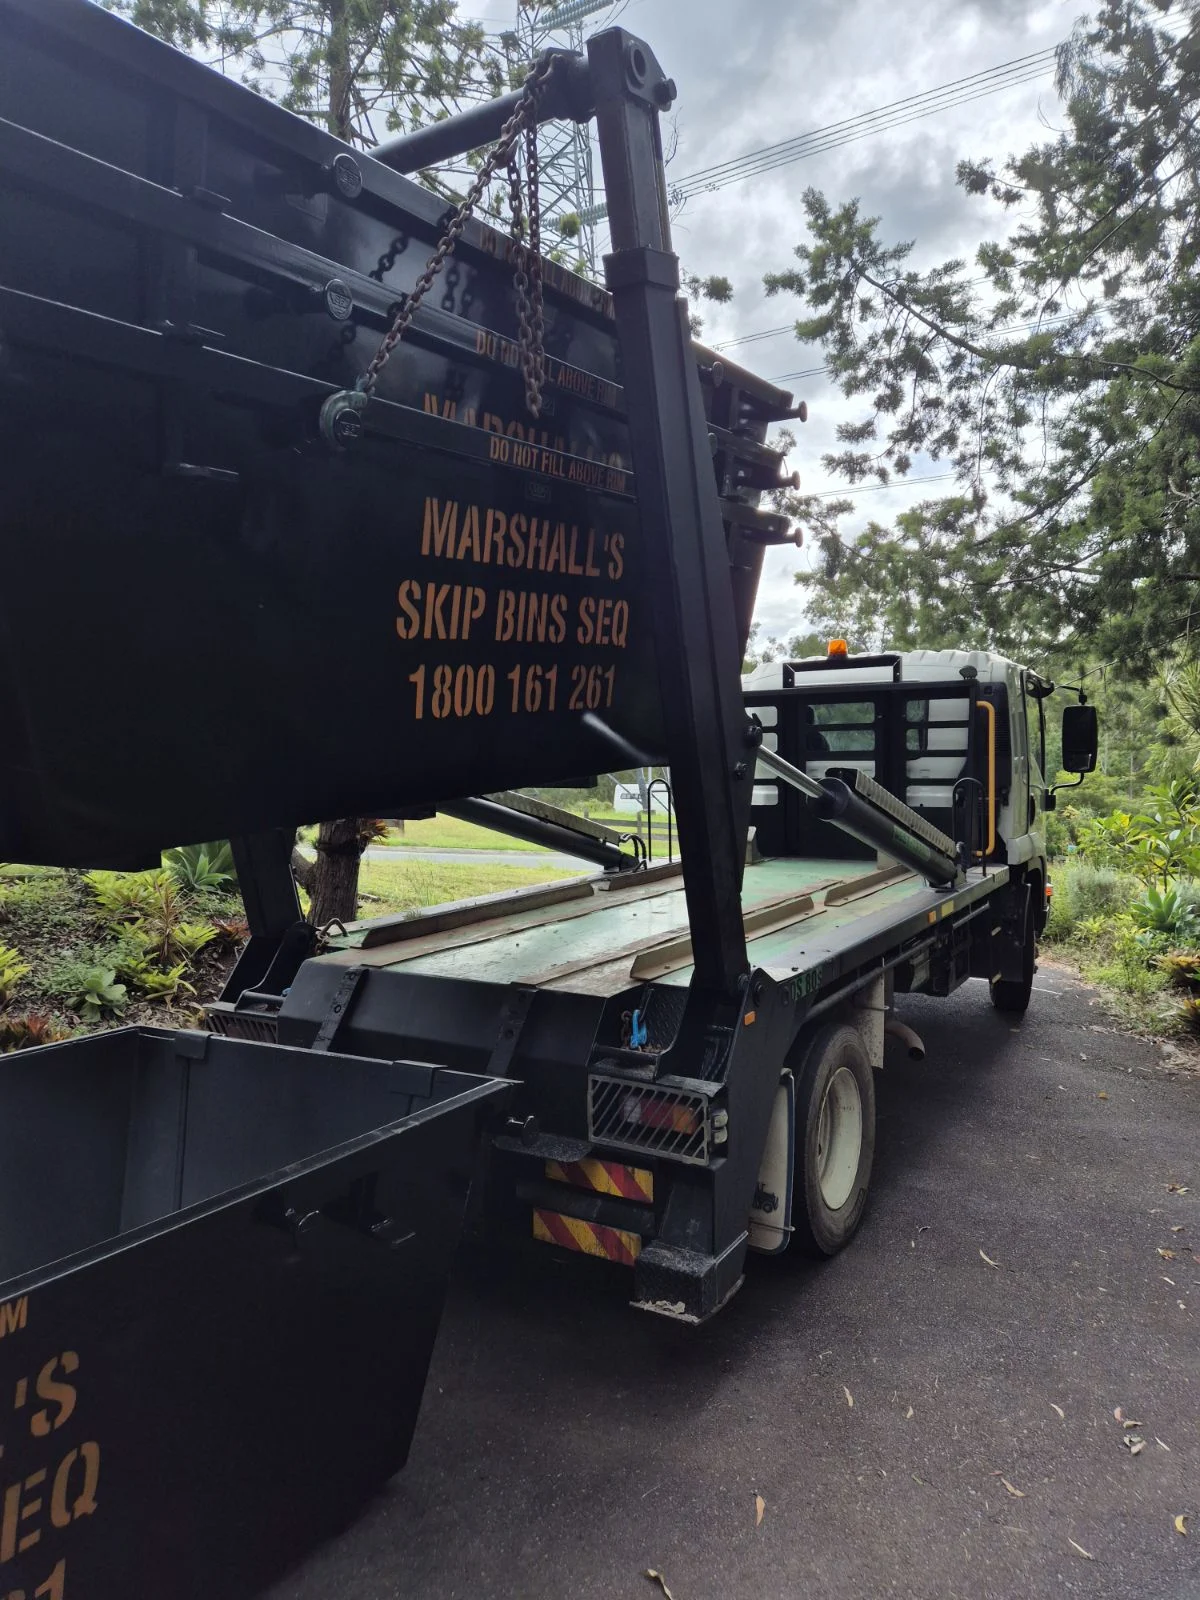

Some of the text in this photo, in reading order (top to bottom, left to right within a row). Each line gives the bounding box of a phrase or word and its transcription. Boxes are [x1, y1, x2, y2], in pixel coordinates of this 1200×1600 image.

[557, 368, 598, 399] ABOVE
[489, 436, 627, 492] DO NOT FILL ABOVE RIM
[420, 496, 625, 580] MARSHALL'S
[396, 579, 630, 648] SKIP BINS SEQ
[408, 664, 616, 719] 1800 161 261
